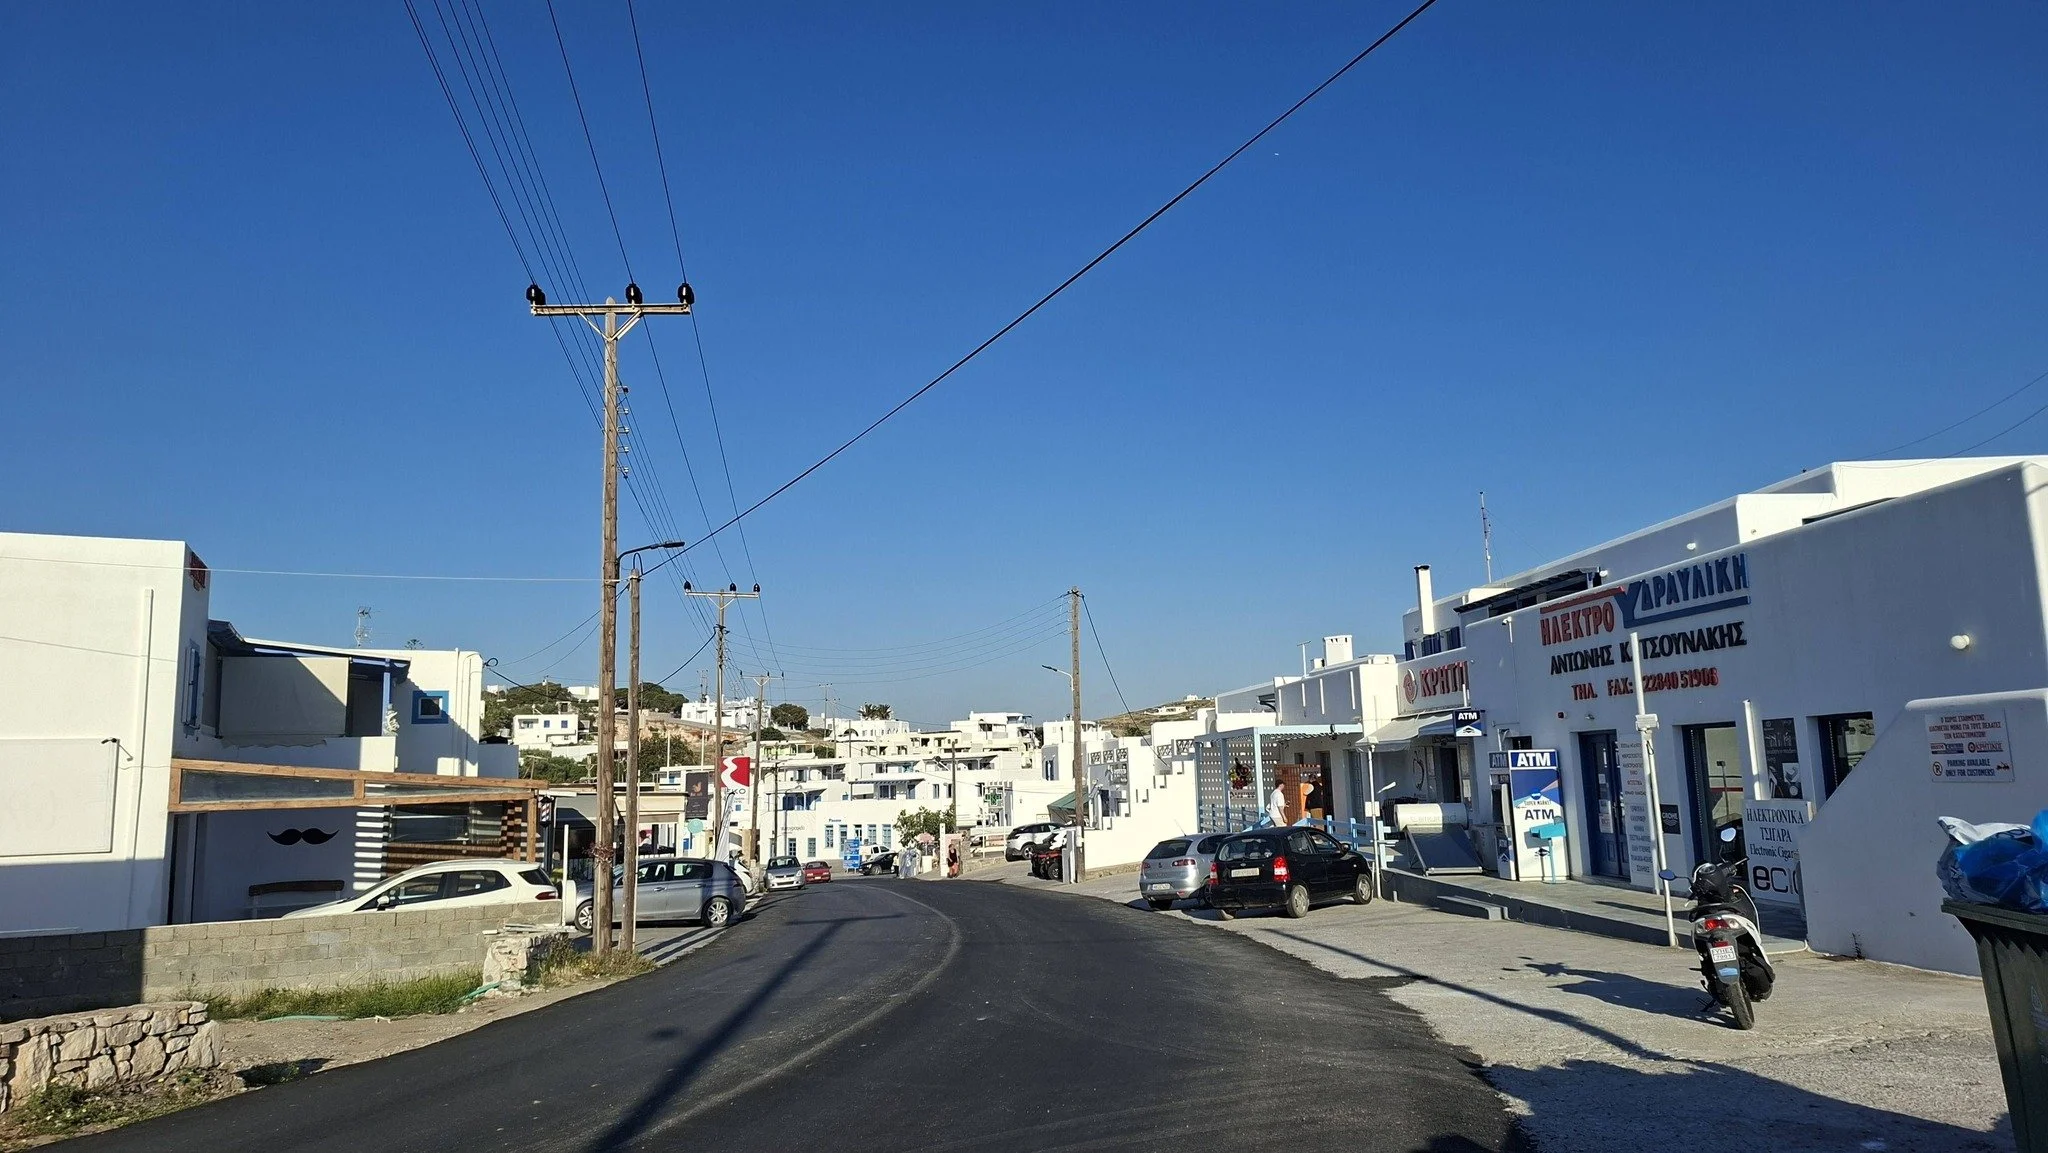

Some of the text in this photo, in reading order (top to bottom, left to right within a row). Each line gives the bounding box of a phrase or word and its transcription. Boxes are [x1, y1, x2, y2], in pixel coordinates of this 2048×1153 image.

[1540, 602, 1615, 645] ΗΛΕΚΤΡΟ
[1551, 644, 1615, 675] ΑΝΤΩΝΗΣ
[1639, 621, 1748, 660] ΤΣΟΥΝΑΚΗΣ
[1571, 683, 1598, 700] ΤΗΛ.
[1607, 677, 1634, 696] FAX:
[1643, 671, 1679, 693] 22840
[1458, 712, 1478, 721] ATM
[1517, 752, 1551, 767] ATM
[1524, 809, 1555, 820] ATM
[1746, 808, 1805, 824] ΗΛΕΚΤΡΟΝΙΚΑ
[1760, 827, 1793, 842] ΤΣΙΓΑΡΑ
[1750, 844, 1777, 857] Electronic
